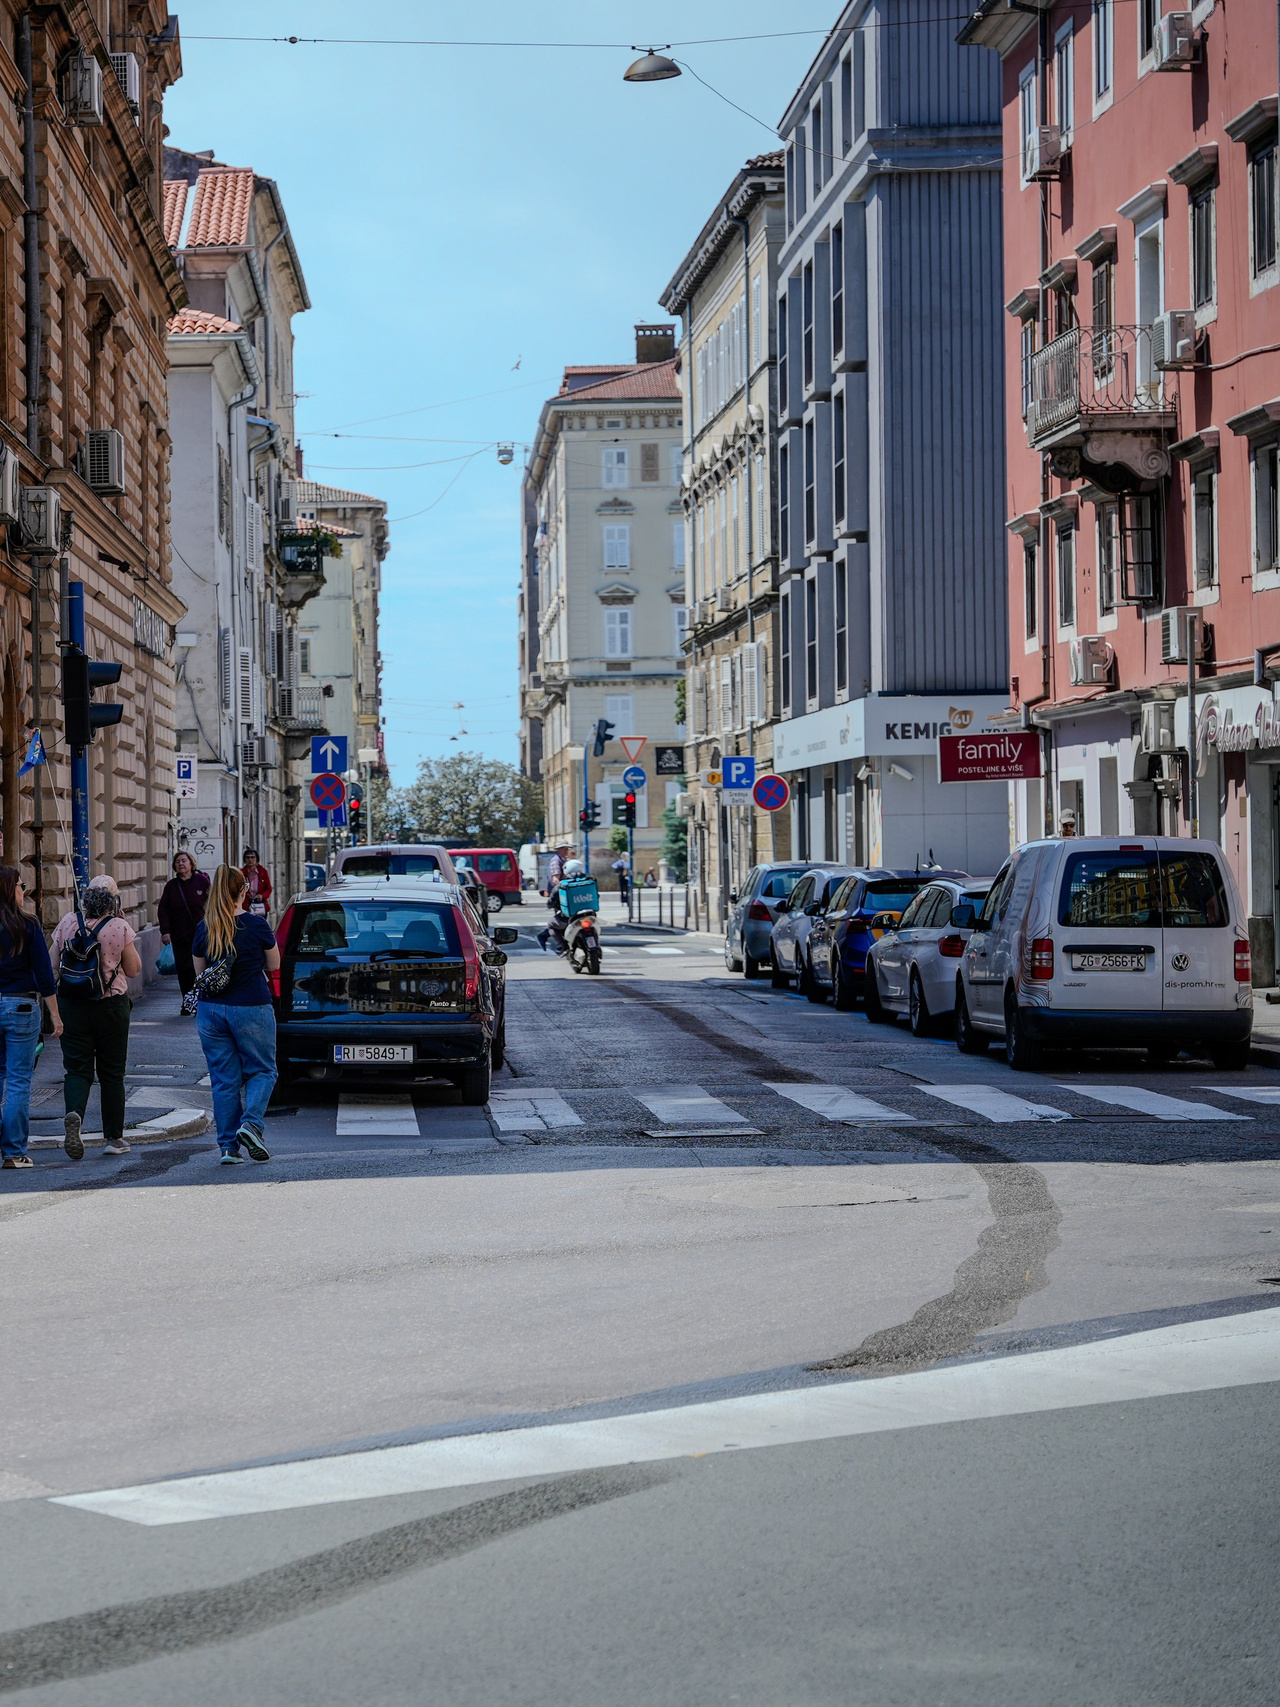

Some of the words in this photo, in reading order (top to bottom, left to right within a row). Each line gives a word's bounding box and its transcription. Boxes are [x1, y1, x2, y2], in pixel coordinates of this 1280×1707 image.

[953, 713, 970, 725] 4U
[957, 736, 1023, 764] family
[180, 762, 190, 777] P
[731, 762, 746, 783] P
[957, 765, 1000, 774] POSTELJINE
[1007, 763, 1024, 772] VIŠE
[573, 893, 594, 903] Wolt
[1080, 955, 1094, 966] ZG
[1101, 955, 1144, 967] 2566-FK
[1165, 980, 1215, 989] dis-prom.hr
[342, 1047, 356, 1060] RI
[365, 1047, 408, 1060] 5849-T
